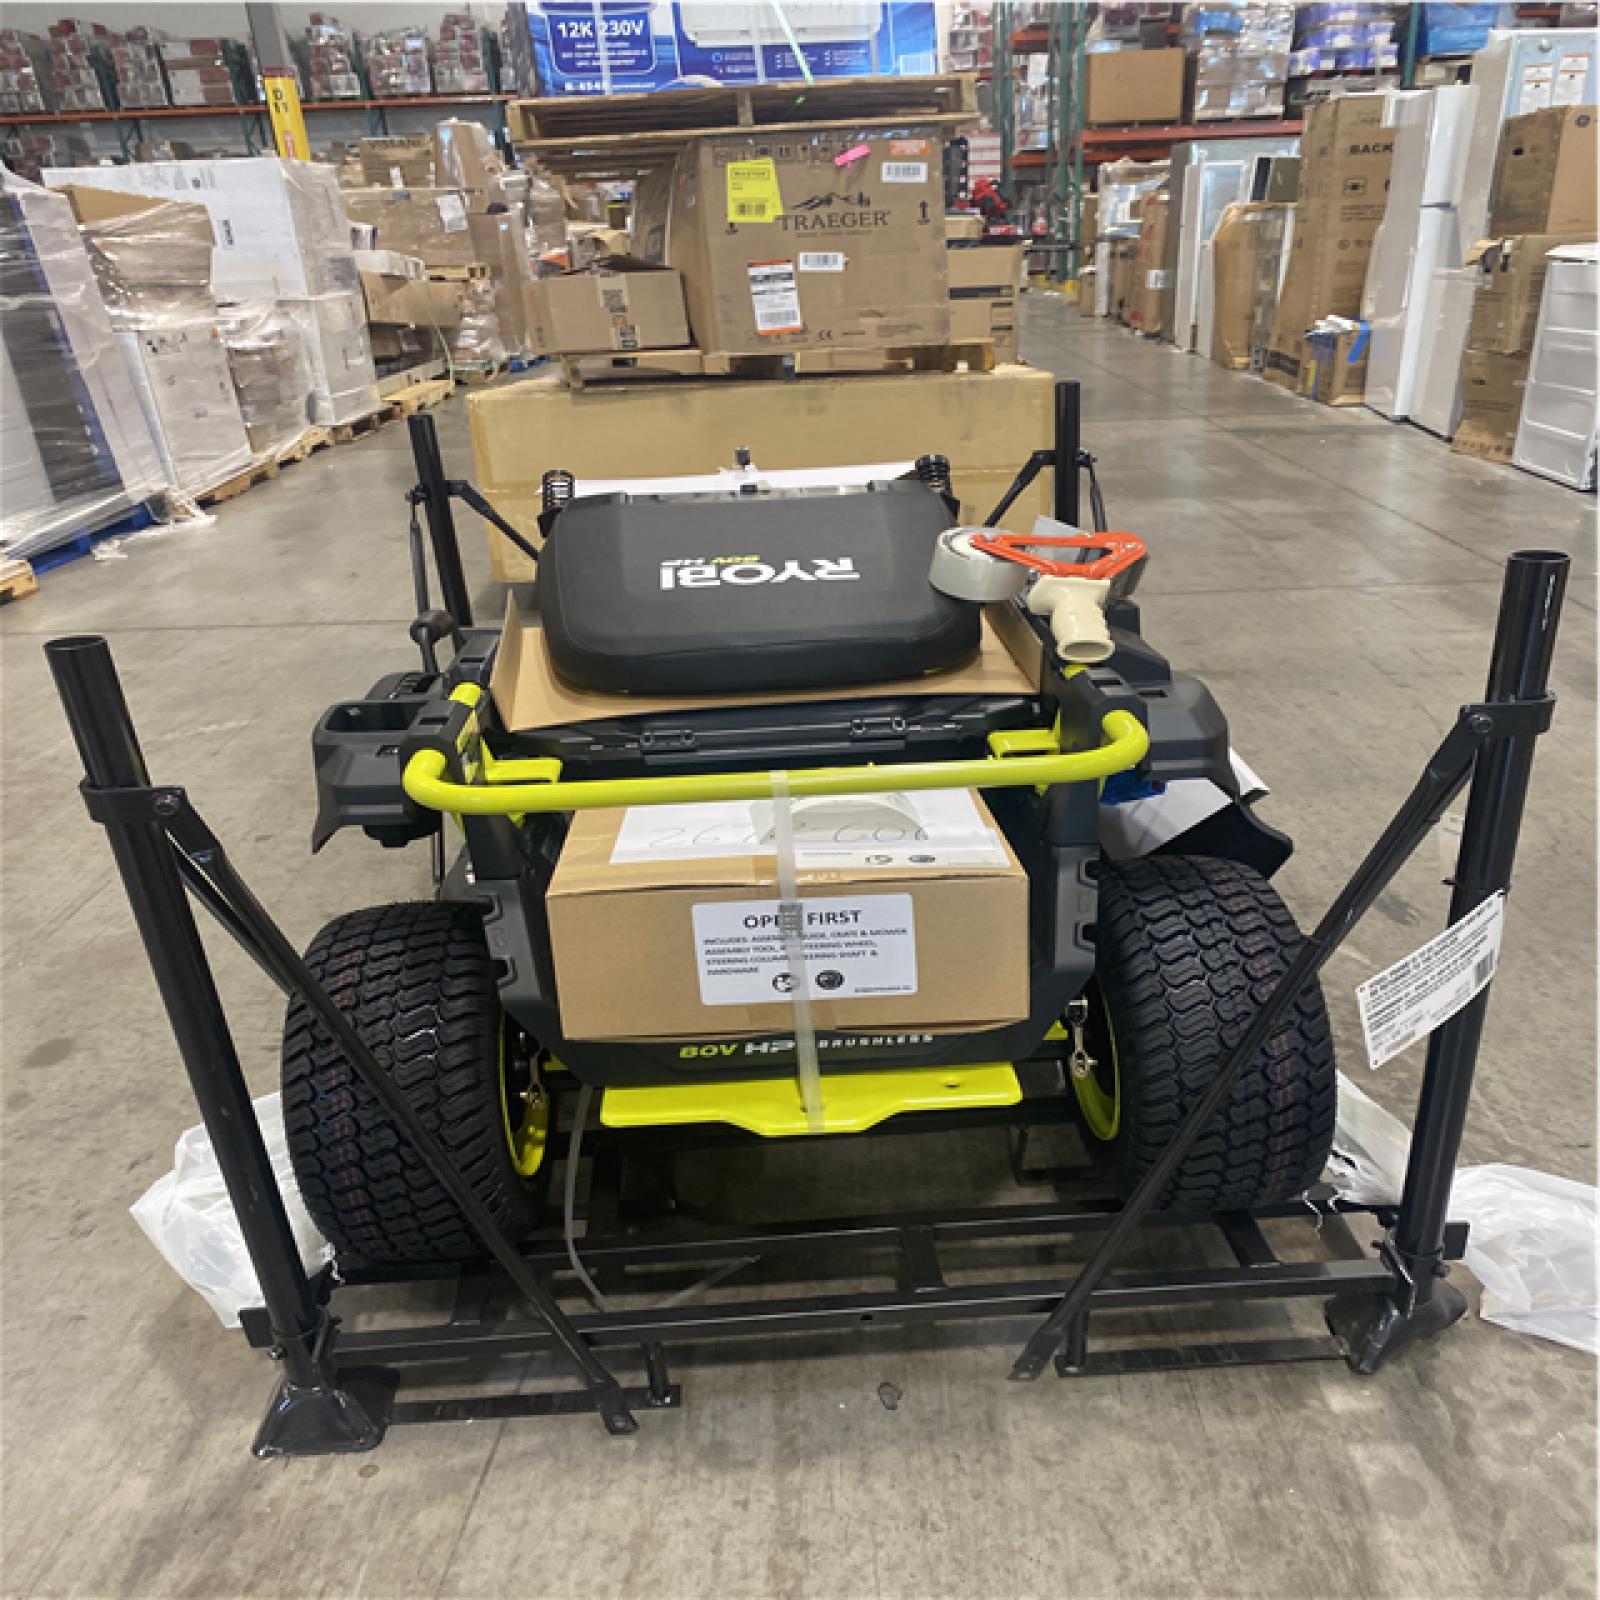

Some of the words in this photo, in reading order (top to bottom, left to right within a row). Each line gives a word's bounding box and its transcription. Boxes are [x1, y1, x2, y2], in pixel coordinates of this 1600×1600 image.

[557, 21, 594, 38] 12K
[600, 19, 643, 36] 230V
[777, 211, 889, 231] TRAEGER
[659, 556, 861, 591] RYOBI
[806, 909, 862, 926] FIRST
[679, 1043, 738, 1059] 80V
[744, 1039, 796, 1055] HP
[817, 1034, 934, 1049] BRUSHLESS
